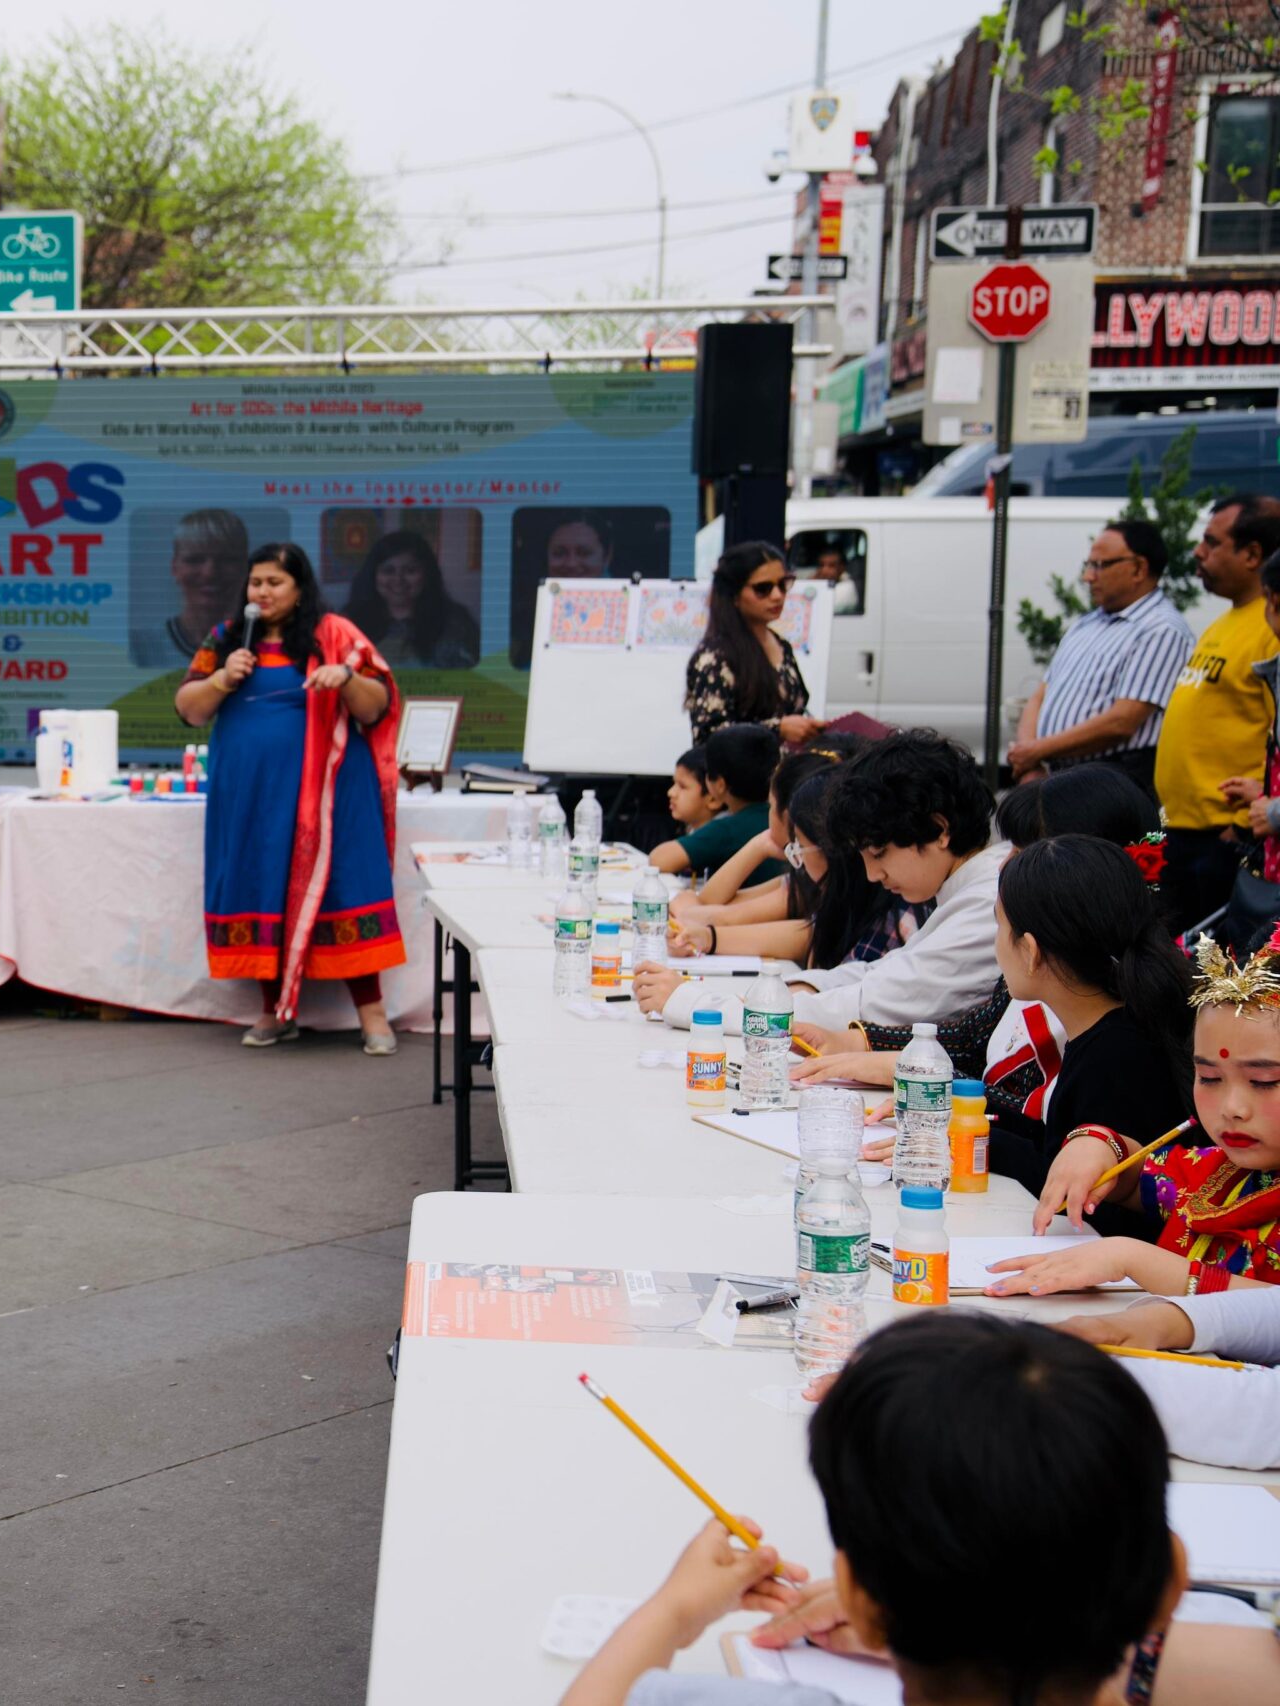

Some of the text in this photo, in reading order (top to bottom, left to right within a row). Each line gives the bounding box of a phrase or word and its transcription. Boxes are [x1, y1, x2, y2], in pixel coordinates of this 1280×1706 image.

[954, 221, 1080, 245] ONE WAY
[29, 267, 68, 283] Route
[975, 285, 1048, 318] STOP
[1092, 289, 1280, 348] LYWOO
[190, 401, 212, 417] Art
[216, 400, 236, 416] for
[283, 400, 306, 415] the
[362, 400, 424, 417] Heritage
[133, 424, 154, 436] Art
[228, 422, 292, 435] Exhibition
[368, 421, 399, 433] with
[402, 420, 450, 433] Culture
[454, 420, 515, 436] Program
[264, 481, 311, 496] Meet
[323, 481, 355, 494] the
